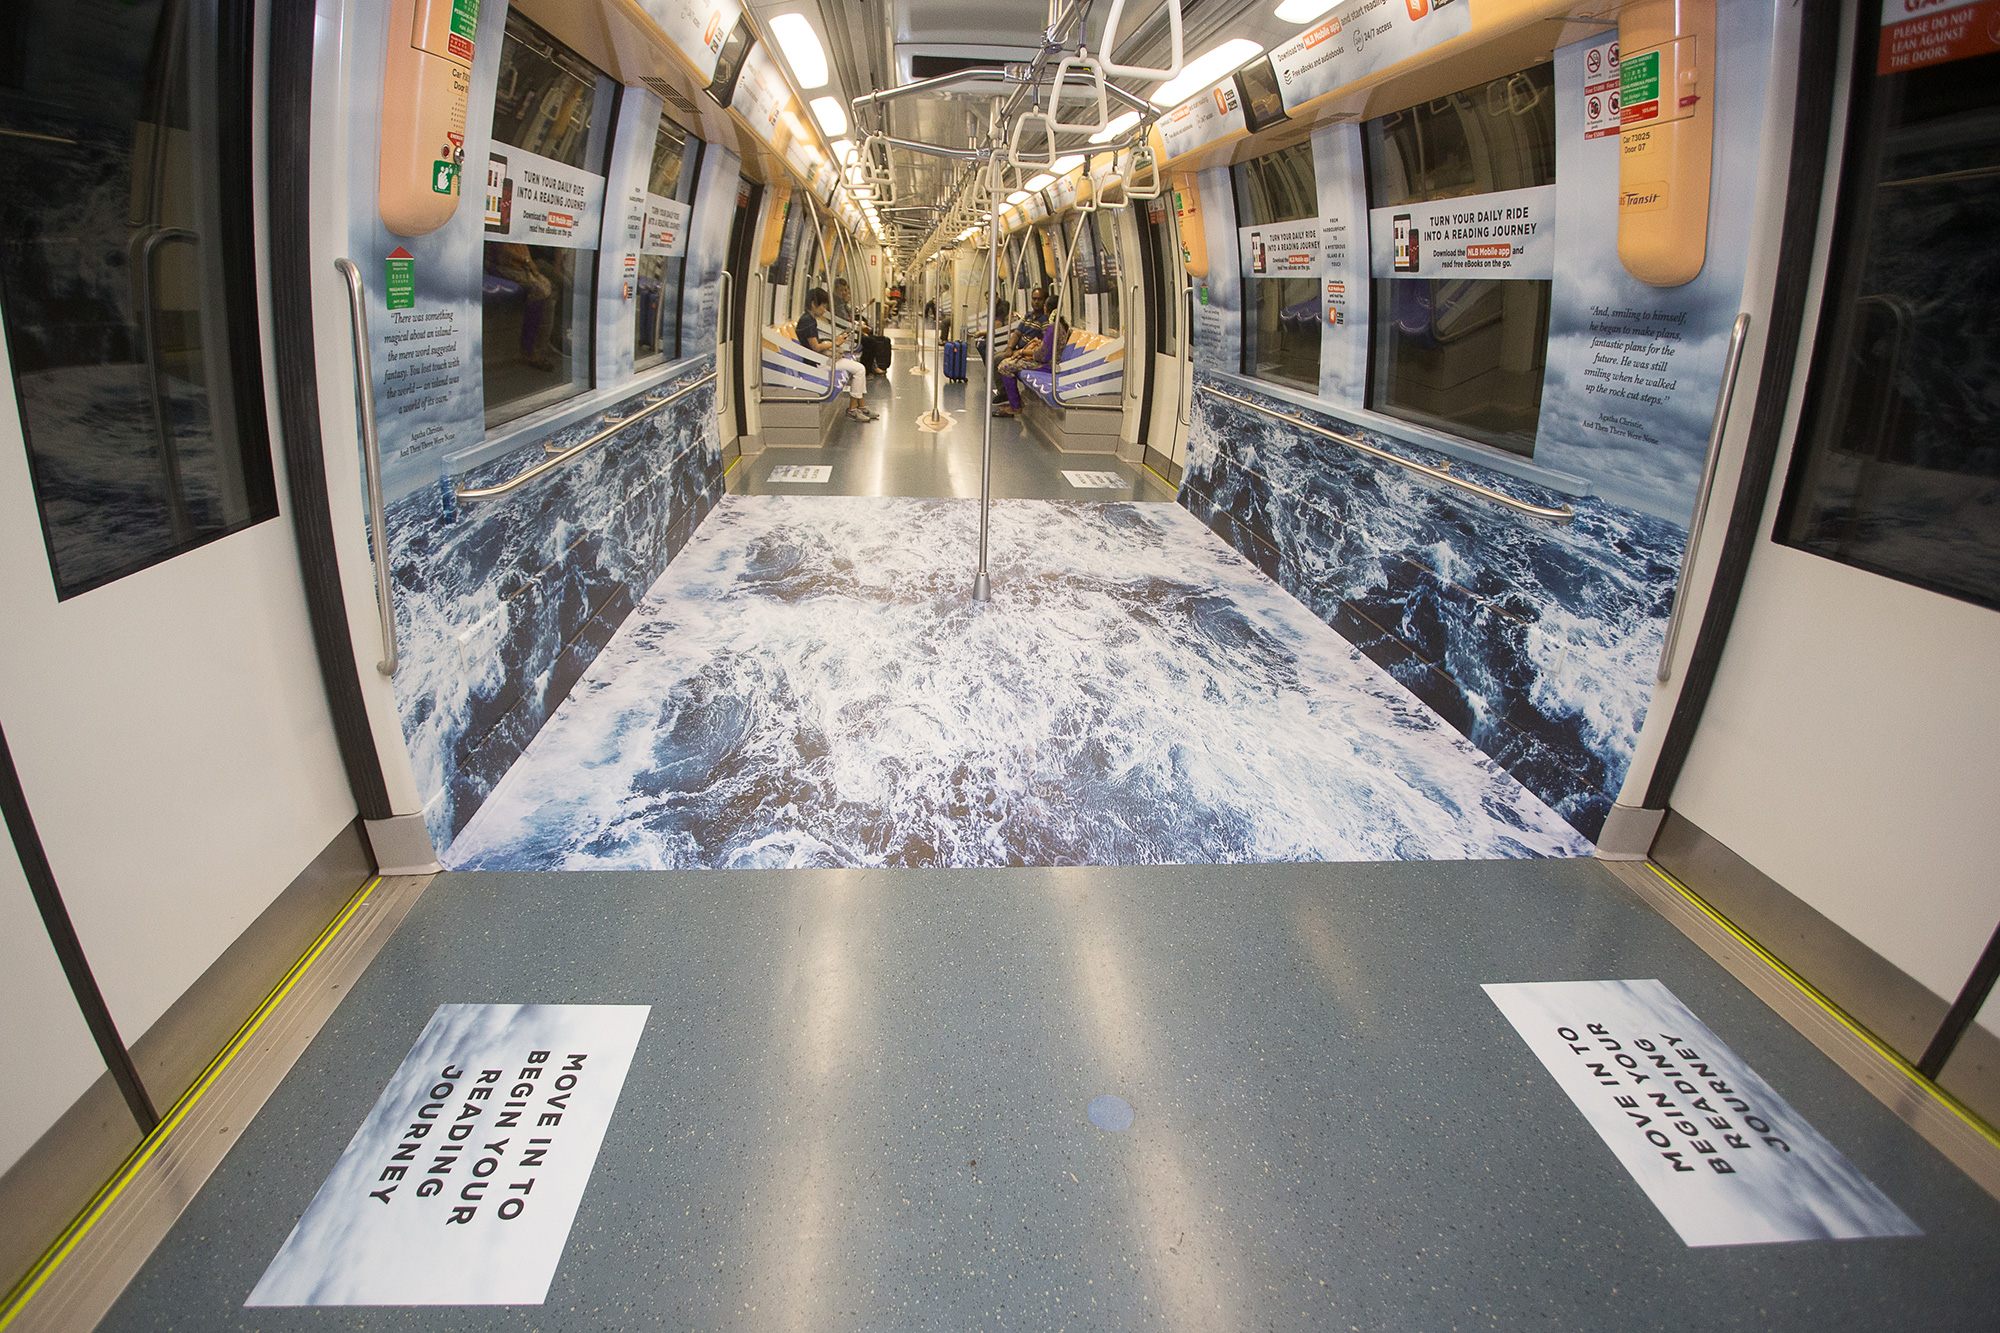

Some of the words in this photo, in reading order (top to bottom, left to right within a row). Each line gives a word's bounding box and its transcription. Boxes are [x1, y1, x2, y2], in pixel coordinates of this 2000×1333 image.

[1277, 44, 1297, 62] Download
[1304, 35, 1315, 47] NLB
[1314, 27, 1331, 41] Mobile
[1330, 23, 1340, 35] app
[1340, 13, 1351, 26] and
[1351, 7, 1365, 24] start
[1364, 29, 1376, 42] 24/7
[1376, 21, 1392, 35] access
[1893, 21, 1929, 39] PLEASE
[1932, 16, 1948, 28] DO
[1950, 9, 1974, 25] NOT
[1892, 39, 1917, 54] LEAN
[1920, 27, 1965, 46] AGAINST
[1292, 66, 1300, 77] Free
[1300, 59, 1313, 74] eBooks
[1321, 45, 1344, 64] audiobooks
[1891, 54, 1909, 67] THE
[1912, 45, 1947, 62] DOORS
[452, 69, 462, 79] Car
[1631, 132, 1650, 142] 73025
[1638, 143, 1646, 151] 07
[525, 171, 540, 185] TURN
[542, 176, 556, 189] YOUR
[558, 180, 572, 193] DAILY
[573, 185, 584, 196] RIDE
[517, 187, 532, 200] INTO
[533, 191, 538, 201] A
[540, 192, 563, 206] READING
[564, 198, 586, 210] JOURNEY
[1626, 193, 1661, 206] Transit
[1430, 214, 1450, 226] TURN
[1452, 212, 1475, 224] YOUR
[1478, 210, 1503, 222] DAILY
[1506, 207, 1529, 219] RIDE
[1306, 230, 1316, 238] RIDE
[1424, 230, 1442, 241] INTO
[1444, 229, 1449, 239] A
[1452, 226, 1489, 239] READING
[1492, 223, 1537, 236] JOURNEY
[1281, 243, 1298, 251] READING
[1300, 241, 1320, 249] JOURNEY
[1433, 249, 1456, 257] Download
[1457, 248, 1465, 256] the
[1468, 248, 1478, 256] NLB
[1480, 247, 1497, 256] Mobile
[1499, 248, 1510, 256] app
[1512, 246, 1523, 254] and
[1464, 259, 1483, 267] eBooks
[1492, 259, 1501, 267] the
[412, 312, 424, 322] was
[425, 310, 453, 322] something
[1612, 308, 1640, 321] smiling
[1643, 311, 1651, 319] to
[1653, 311, 1687, 325] himself,
[384, 330, 408, 346] magical
[410, 329, 425, 339] about
[435, 326, 451, 337] island
[1589, 322, 1597, 331] he
[1600, 322, 1621, 335] began
[1632, 326, 1654, 336] make
[1655, 328, 1681, 342] plans,
[388, 350, 397, 362] the
[399, 351, 414, 360] mere
[415, 345, 430, 356] word
[431, 342, 456, 357] suggested
[1590, 337, 1623, 349] fantastic
[1624, 341, 1646, 352] plans
[1646, 343, 1660, 356] for
[1661, 345, 1675, 356] the
[410, 365, 420, 376] You
[422, 363, 431, 374] lost
[432, 360, 447, 371] touch
[448, 357, 460, 368] with
[1593, 353, 1618, 364] future.
[1621, 356, 1632, 366] He
[1633, 361, 1649, 369] was
[1651, 361, 1667, 372] still
[387, 388, 397, 399] the
[398, 382, 415, 396] world
[424, 382, 430, 390] an
[432, 375, 448, 388] island
[449, 376, 459, 384] was
[1584, 368, 1611, 382] smiling
[1612, 372, 1632, 383] when
[1634, 374, 1644, 384] he
[1645, 378, 1677, 390] walked
[1585, 384, 1595, 394] up
[1596, 384, 1608, 394] the
[1609, 388, 1625, 398] rock
[1627, 391, 1639, 399] cut
[399, 406, 402, 414] a
[404, 399, 420, 412] world
[421, 396, 427, 410] of
[1599, 413, 1618, 423] Agatha
[1582, 420, 1594, 428] And
[1594, 422, 1608, 432] Then
[1610, 426, 1626, 436] There
[1627, 431, 1642, 440] Were
[1642, 434, 1659, 445] None
[1557, 1027, 1590, 1055] TO
[1586, 1023, 1650, 1084] YOUR
[1586, 1062, 1621, 1086] IN
[494, 1051, 551, 1128] BEGIN
[537, 1054, 588, 1127] MOVE
[1634, 1038, 1751, 1149] READING
[1659, 1033, 1790, 1152] JOURNEY
[369, 1065, 464, 1205] JOURNEY
[416, 1069, 503, 1198] READING
[1613, 1095, 1695, 1172] MOVE
[1647, 1092, 1736, 1174] BEGIN
[519, 1138, 552, 1167] IN
[446, 1137, 510, 1225] YOUR
[497, 1178, 536, 1220] TO
